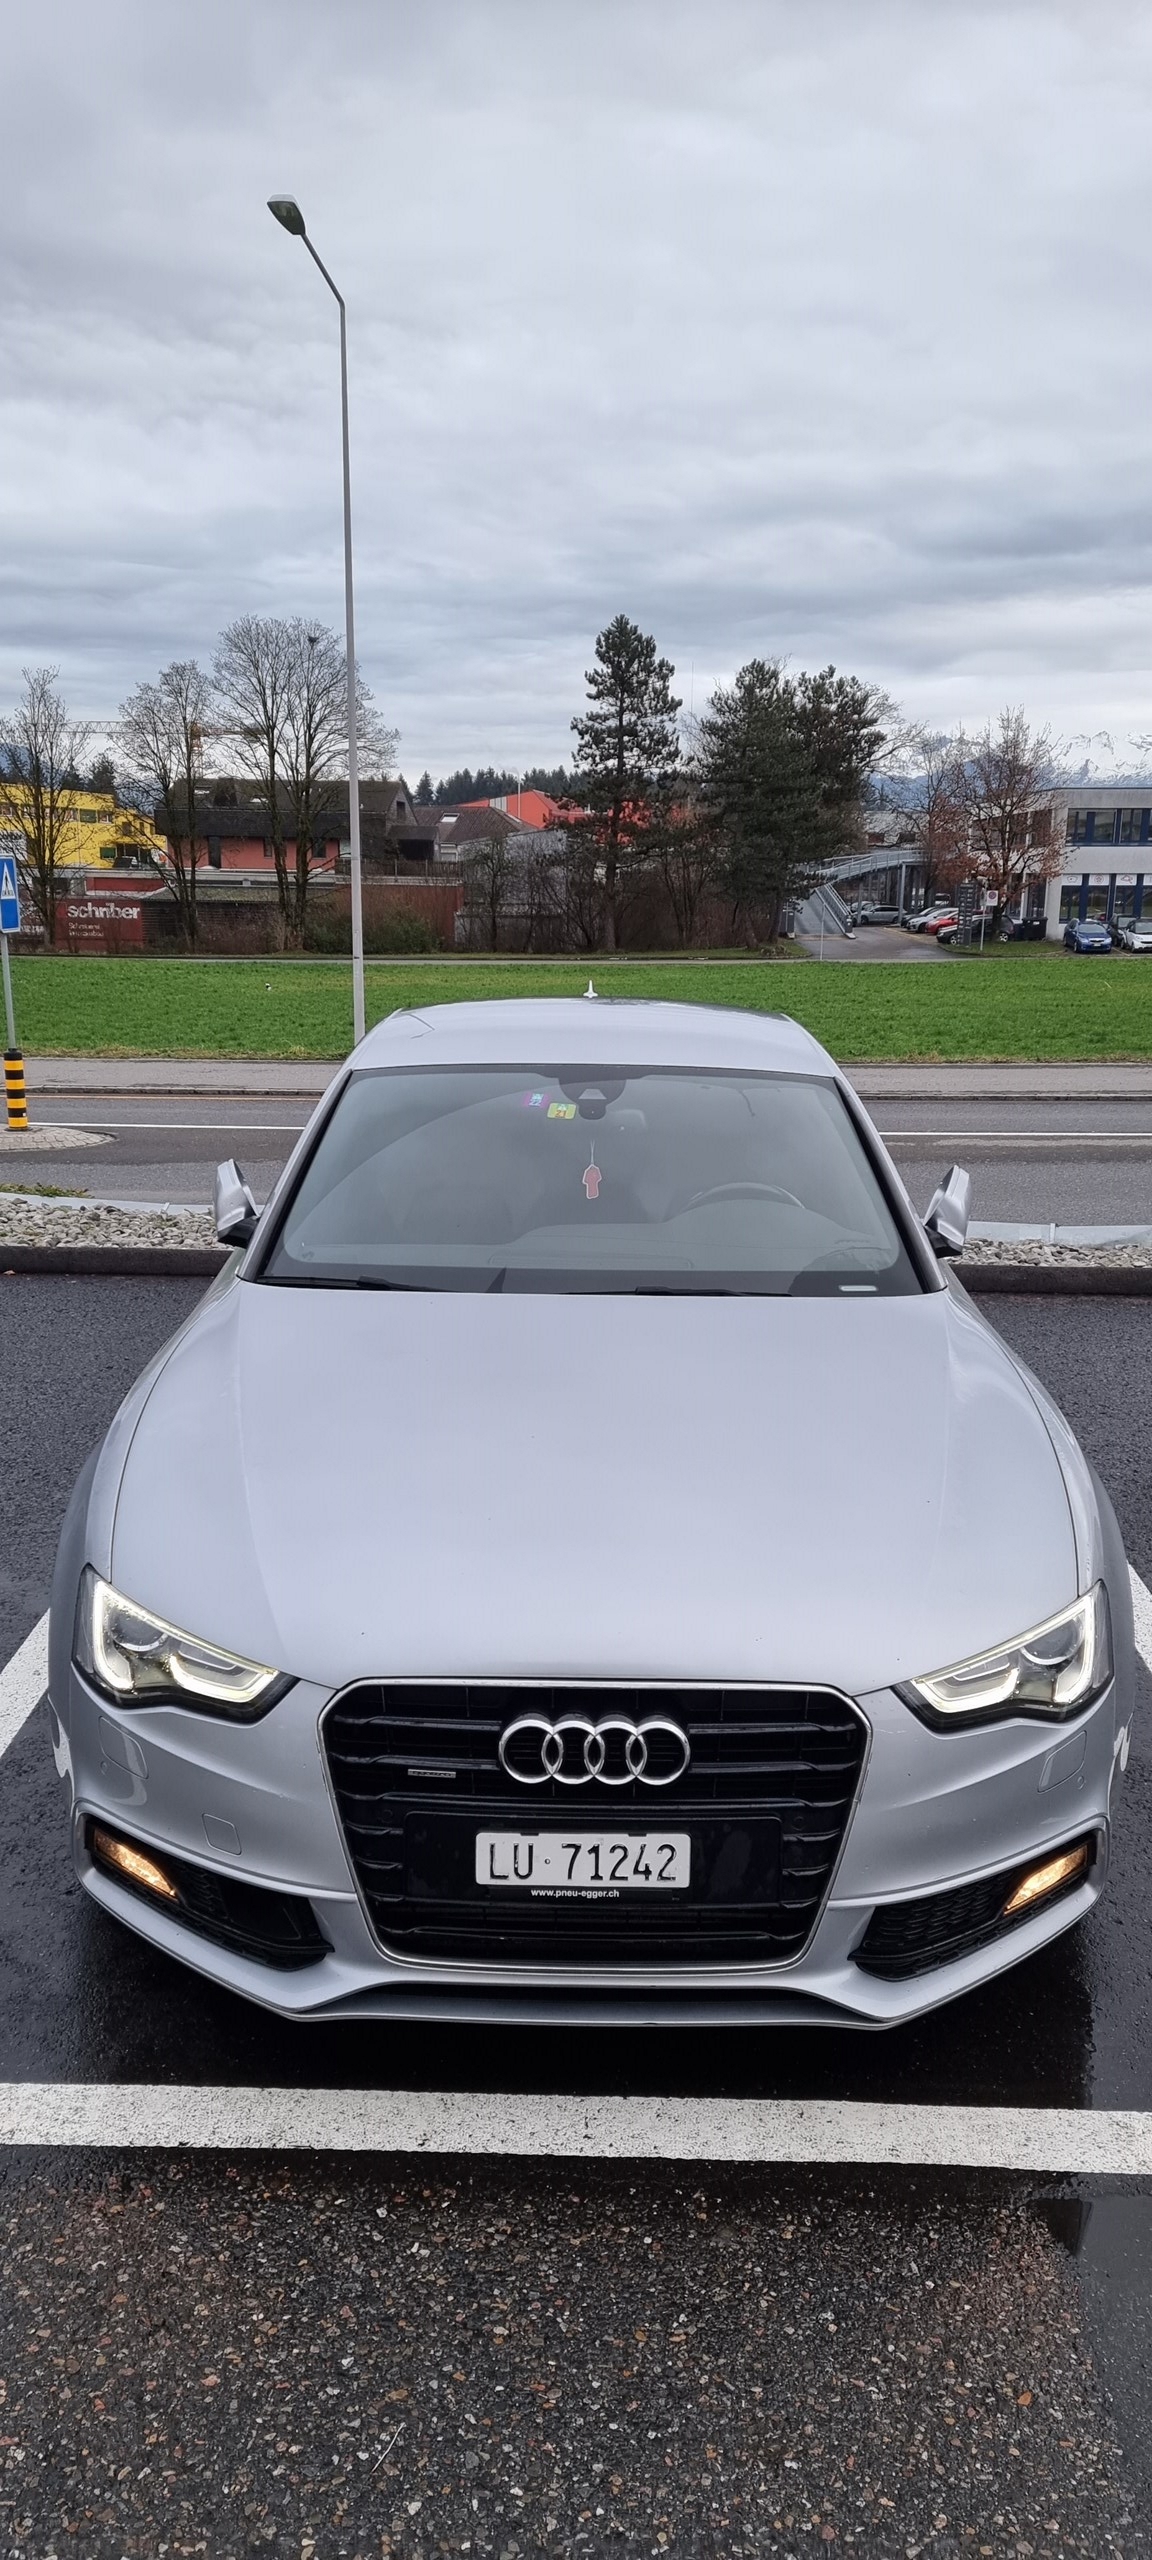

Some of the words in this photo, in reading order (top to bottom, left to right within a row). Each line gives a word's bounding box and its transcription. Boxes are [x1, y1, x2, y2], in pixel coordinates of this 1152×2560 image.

[489, 1842, 534, 1880] LU
[561, 1843, 677, 1881] 71242
[530, 1888, 620, 1899] www.pneu-egger.ch
